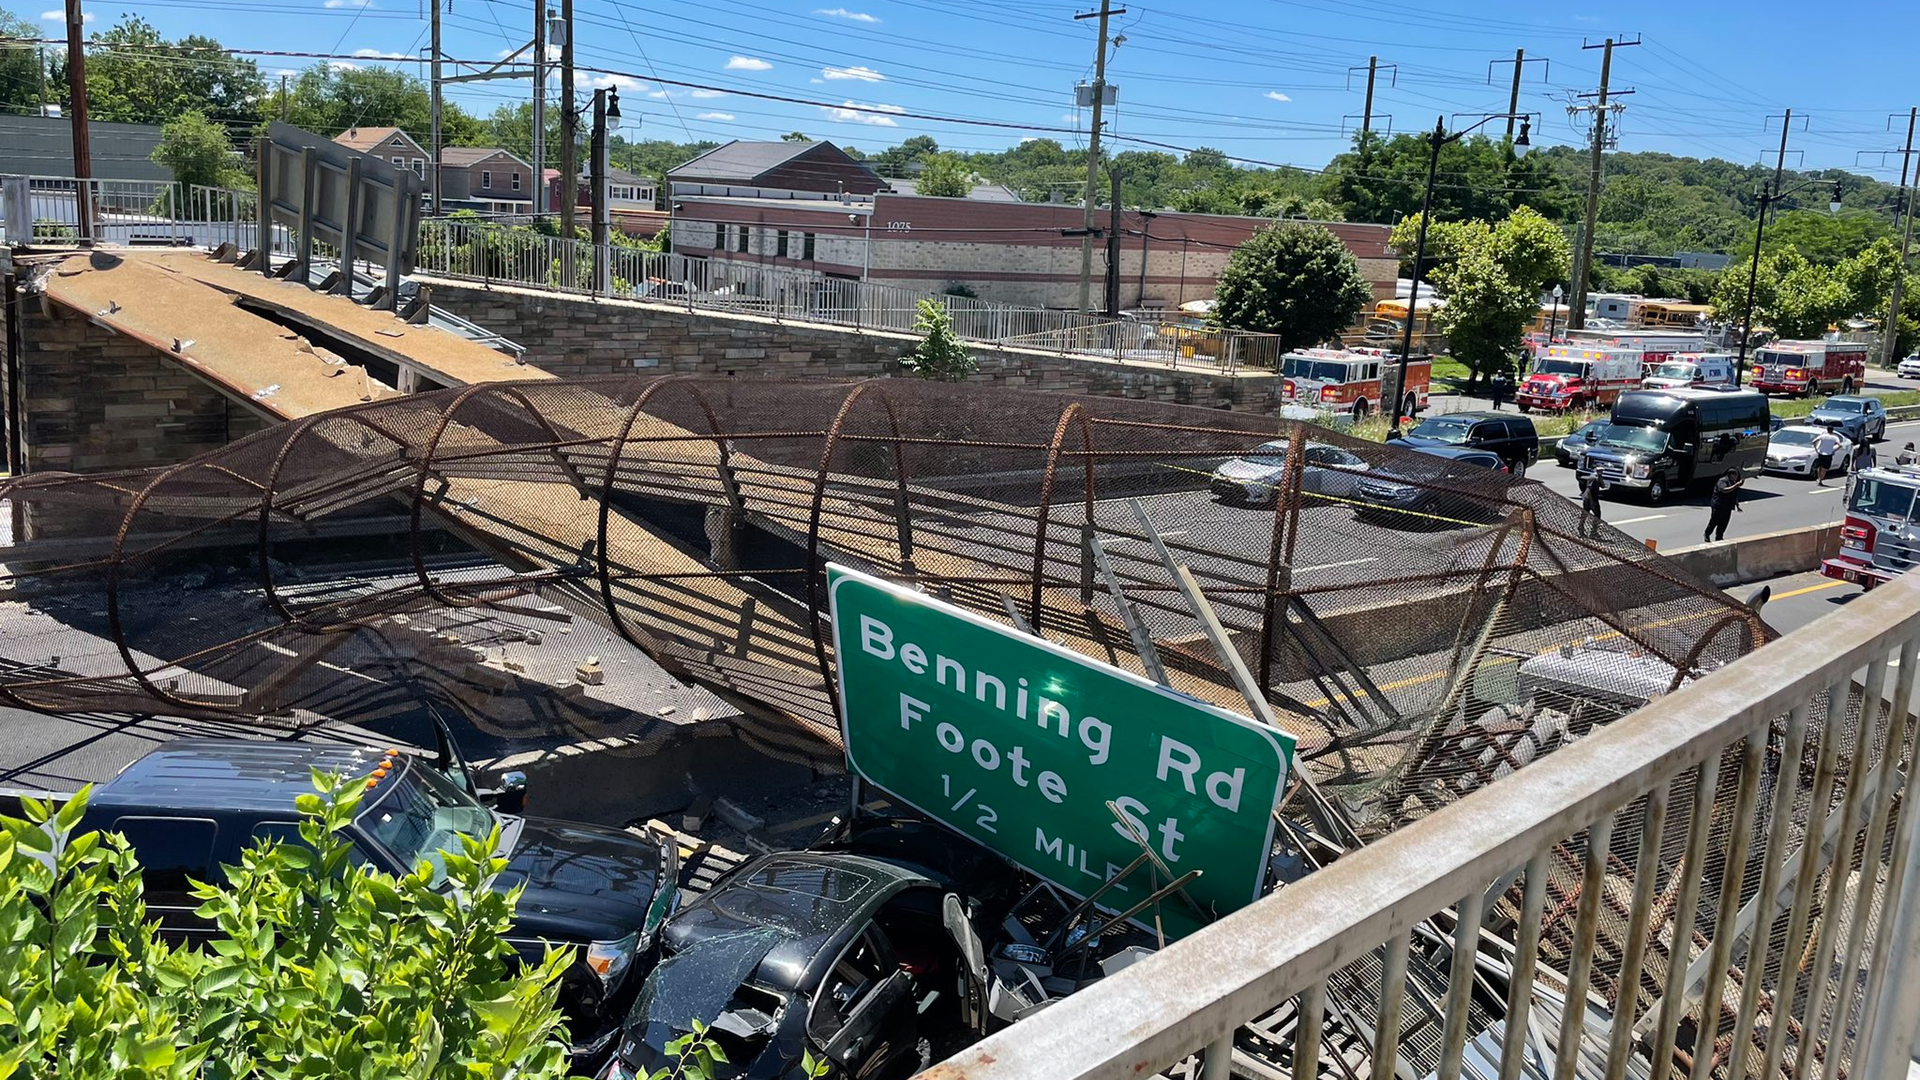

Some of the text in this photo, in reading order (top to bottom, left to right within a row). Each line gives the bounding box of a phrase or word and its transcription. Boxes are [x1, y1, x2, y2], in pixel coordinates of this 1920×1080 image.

[887, 221, 911, 233] 1075
[860, 613, 1246, 813] Benning Rd
[899, 692, 1185, 862] Foote St
[941, 773, 1129, 892] 1/2 MILE
